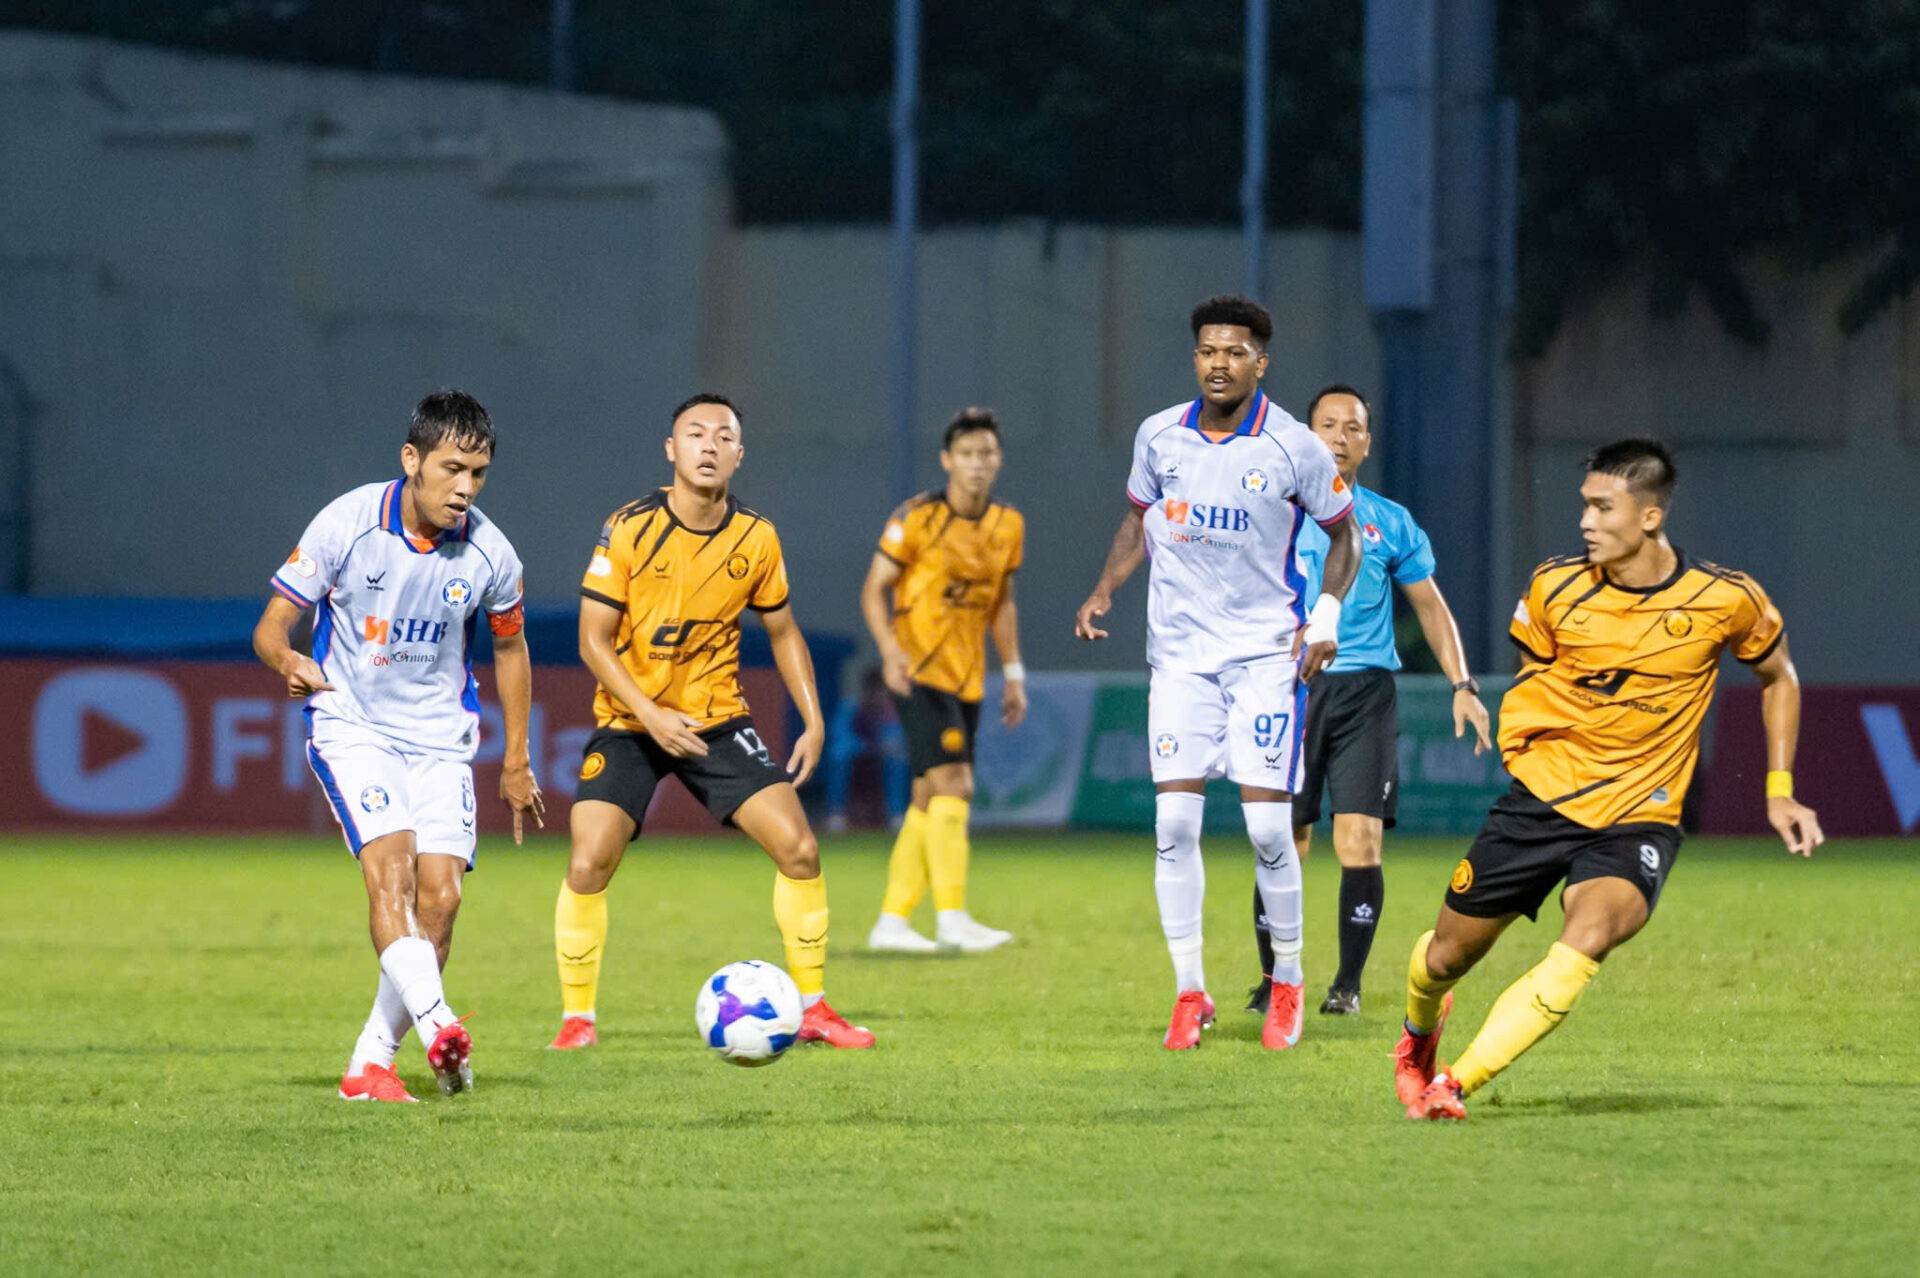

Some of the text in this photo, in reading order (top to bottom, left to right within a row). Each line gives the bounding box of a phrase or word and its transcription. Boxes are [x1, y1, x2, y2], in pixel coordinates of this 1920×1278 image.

[1190, 503, 1249, 532] SHB
[390, 617, 448, 644] SHB
[1254, 713, 1290, 748] 97
[1640, 844, 1660, 870] 9
